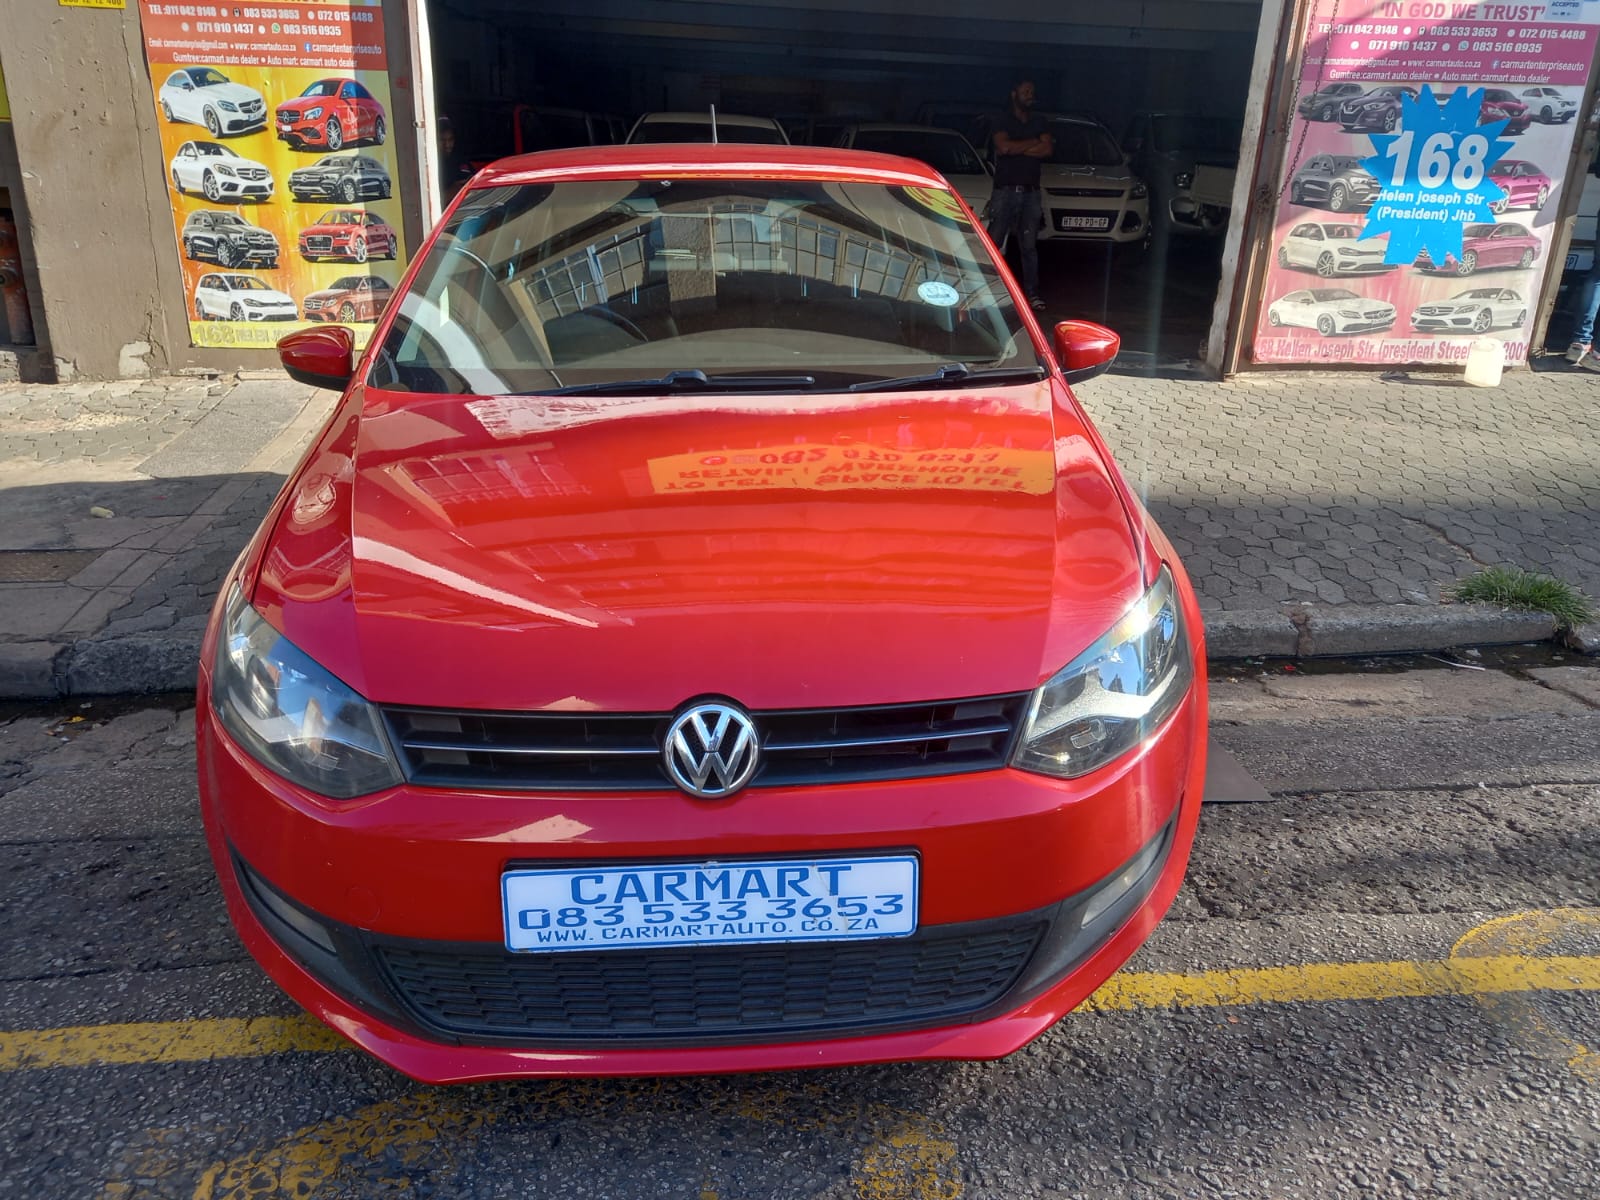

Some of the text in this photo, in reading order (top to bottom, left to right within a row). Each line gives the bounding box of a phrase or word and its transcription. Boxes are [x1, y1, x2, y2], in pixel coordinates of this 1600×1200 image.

[317, 10, 333, 21] 072
[334, 11, 350, 21] 015
[1408, 3, 1445, 17] GOD
[1451, 4, 1478, 18] WE
[196, 22, 342, 36] 071 910 1437 083 516 0935
[1354, 24, 1373, 35] 042
[1374, 24, 1398, 35] 9148
[1430, 26, 1450, 36] 083
[1451, 26, 1471, 37] 533
[1471, 27, 1498, 38] 3653
[1519, 28, 1537, 39] 072
[1539, 29, 1558, 39] 015
[1559, 29, 1587, 40] 4488
[1368, 40, 1543, 53] 071 910 1437 083 516 0935
[225, 54, 240, 64] auto
[240, 54, 259, 65] dealer
[267, 55, 281, 65] Auto
[300, 57, 323, 66] carmart
[324, 58, 338, 67] auto
[338, 58, 358, 68] dealer
[1500, 60, 1585, 72] carmartenterpriseauto
[1391, 70, 1408, 80] auto
[1409, 71, 1432, 80] dealer
[1441, 71, 1459, 81] Auto
[1480, 73, 1509, 83] carmart
[1509, 74, 1527, 83] auto
[1527, 74, 1551, 84] dealer
[1386, 130, 1489, 191] 168
[1377, 190, 1414, 202] Helen
[1464, 193, 1485, 205] Str
[1377, 206, 1476, 223] (President) Jhb
[1314, 339, 1355, 358] Joseph
[1378, 339, 1436, 362] (president
[666, 704, 758, 797] VW
[570, 865, 852, 906] CARMART
[517, 893, 904, 931] 083 533 3653
